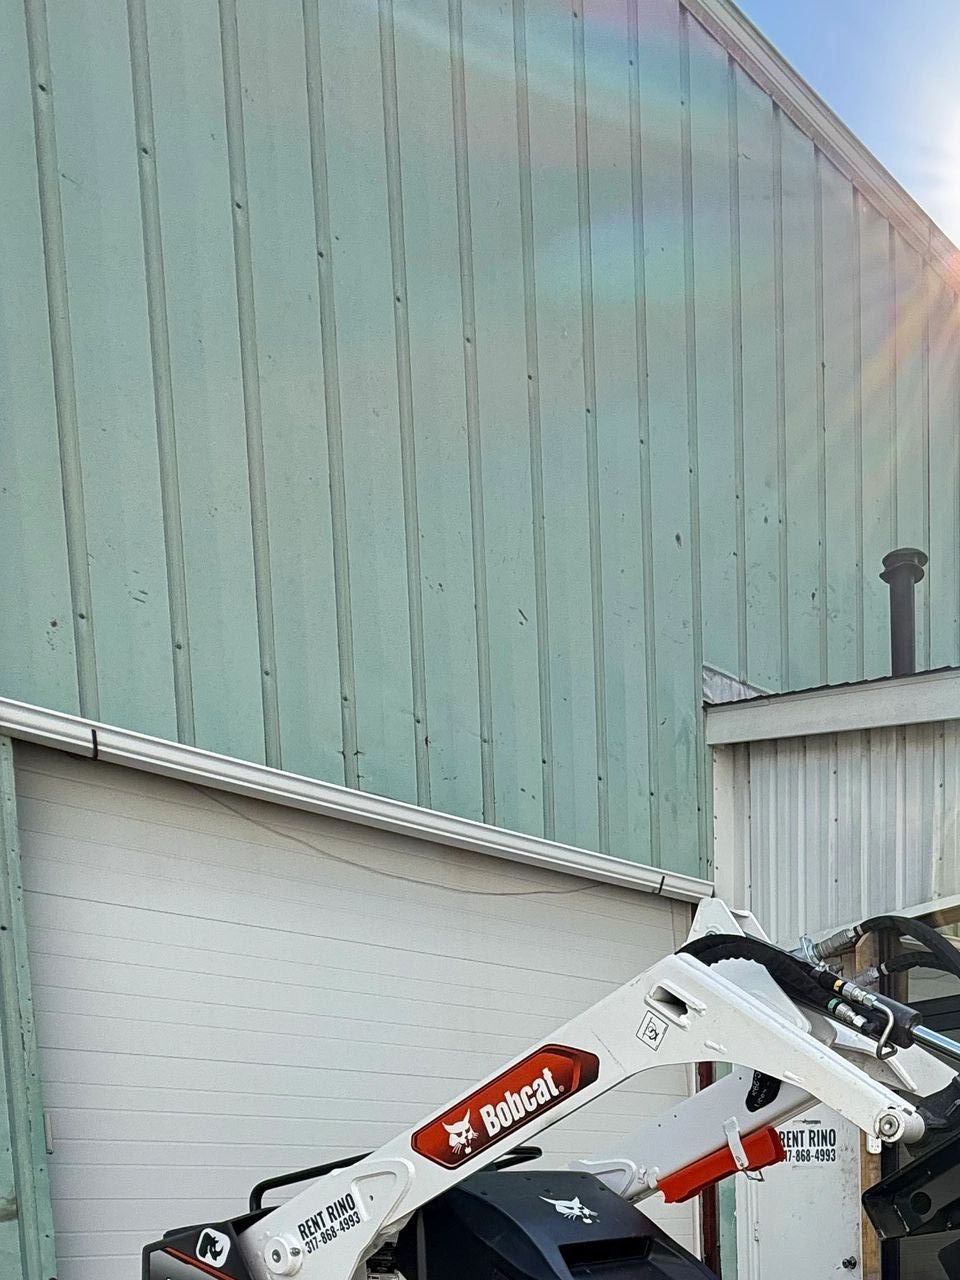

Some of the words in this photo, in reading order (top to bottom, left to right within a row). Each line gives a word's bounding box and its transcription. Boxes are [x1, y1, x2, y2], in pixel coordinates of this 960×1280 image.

[479, 1067, 560, 1137] Bobcat
[779, 1130, 805, 1148] RENT
[809, 1129, 836, 1147] RINO
[784, 1148, 836, 1162] 17-868-4993
[298, 1211, 327, 1241] RENT
[326, 1193, 356, 1223] RINO
[305, 1211, 360, 1254] 317-868-4993
